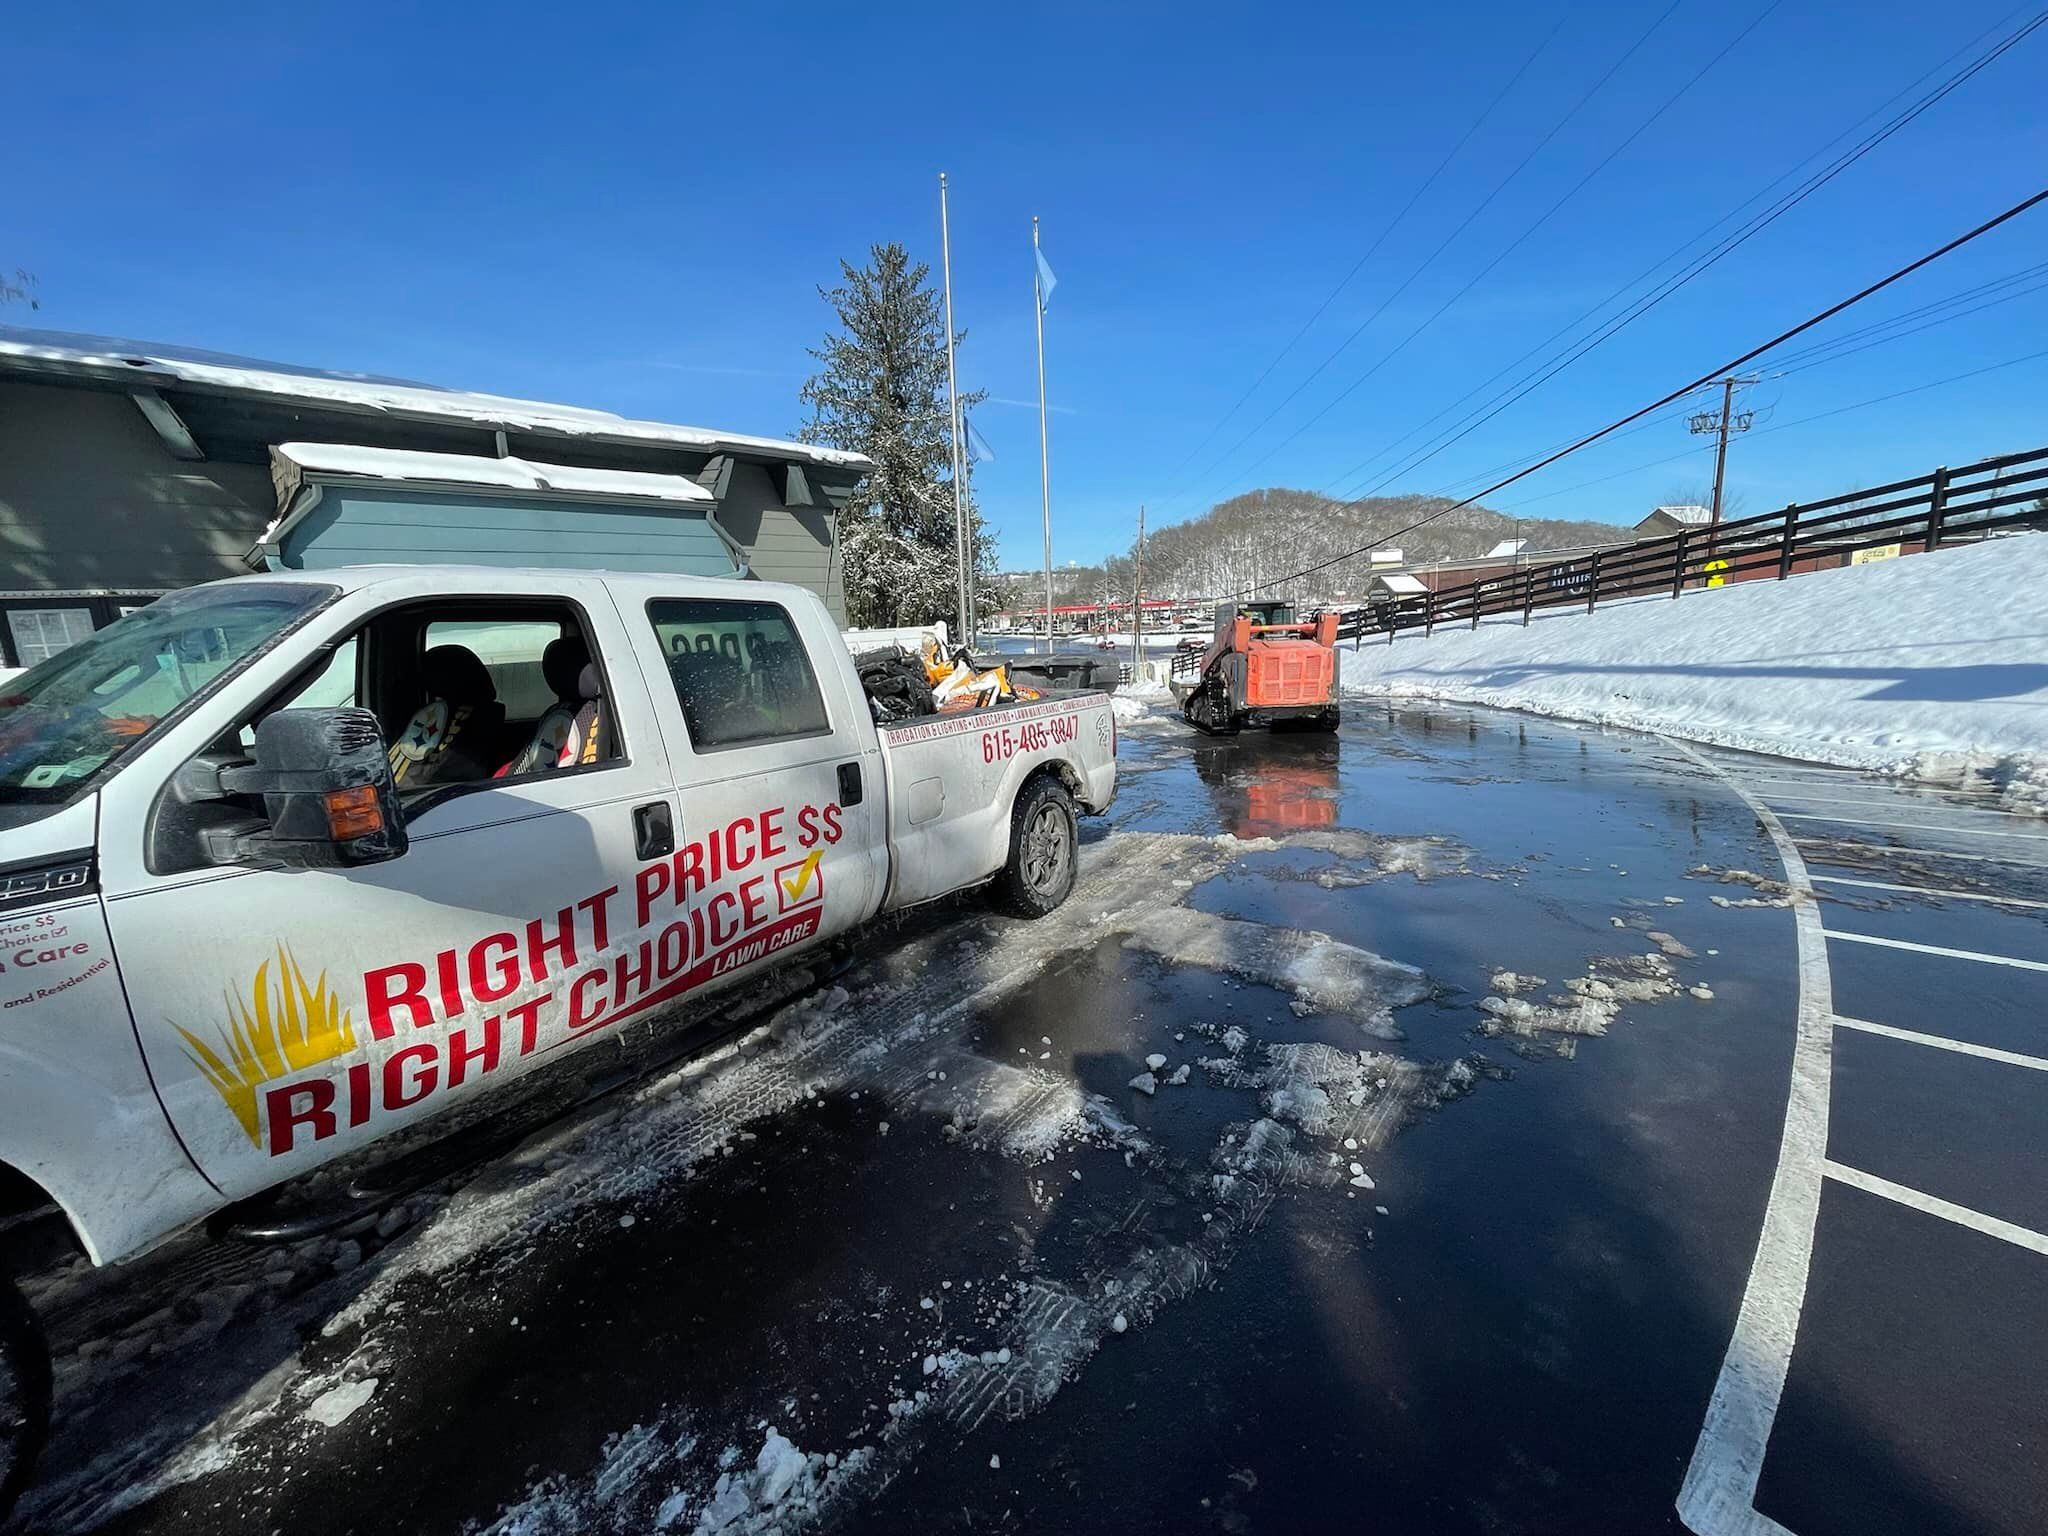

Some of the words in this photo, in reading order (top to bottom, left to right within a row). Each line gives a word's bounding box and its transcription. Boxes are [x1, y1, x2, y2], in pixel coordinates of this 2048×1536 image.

[887, 726, 932, 745] IRRIGATION
[937, 718, 968, 736] LIGHTING
[972, 711, 1011, 729] LANDSCAPING
[0, 867, 90, 899] 50
[0, 922, 31, 937] rice
[364, 885, 618, 1041] RIGHT
[636, 806, 786, 928] PRICE
[797, 802, 843, 848] $$
[14, 942, 89, 968] Care
[712, 938, 767, 976] LAWN
[769, 918, 814, 951] CARE
[4, 993, 35, 1009] and
[37, 958, 110, 999] Residential
[266, 992, 552, 1157] RIGHT
[569, 875, 768, 1028] CHOICE
